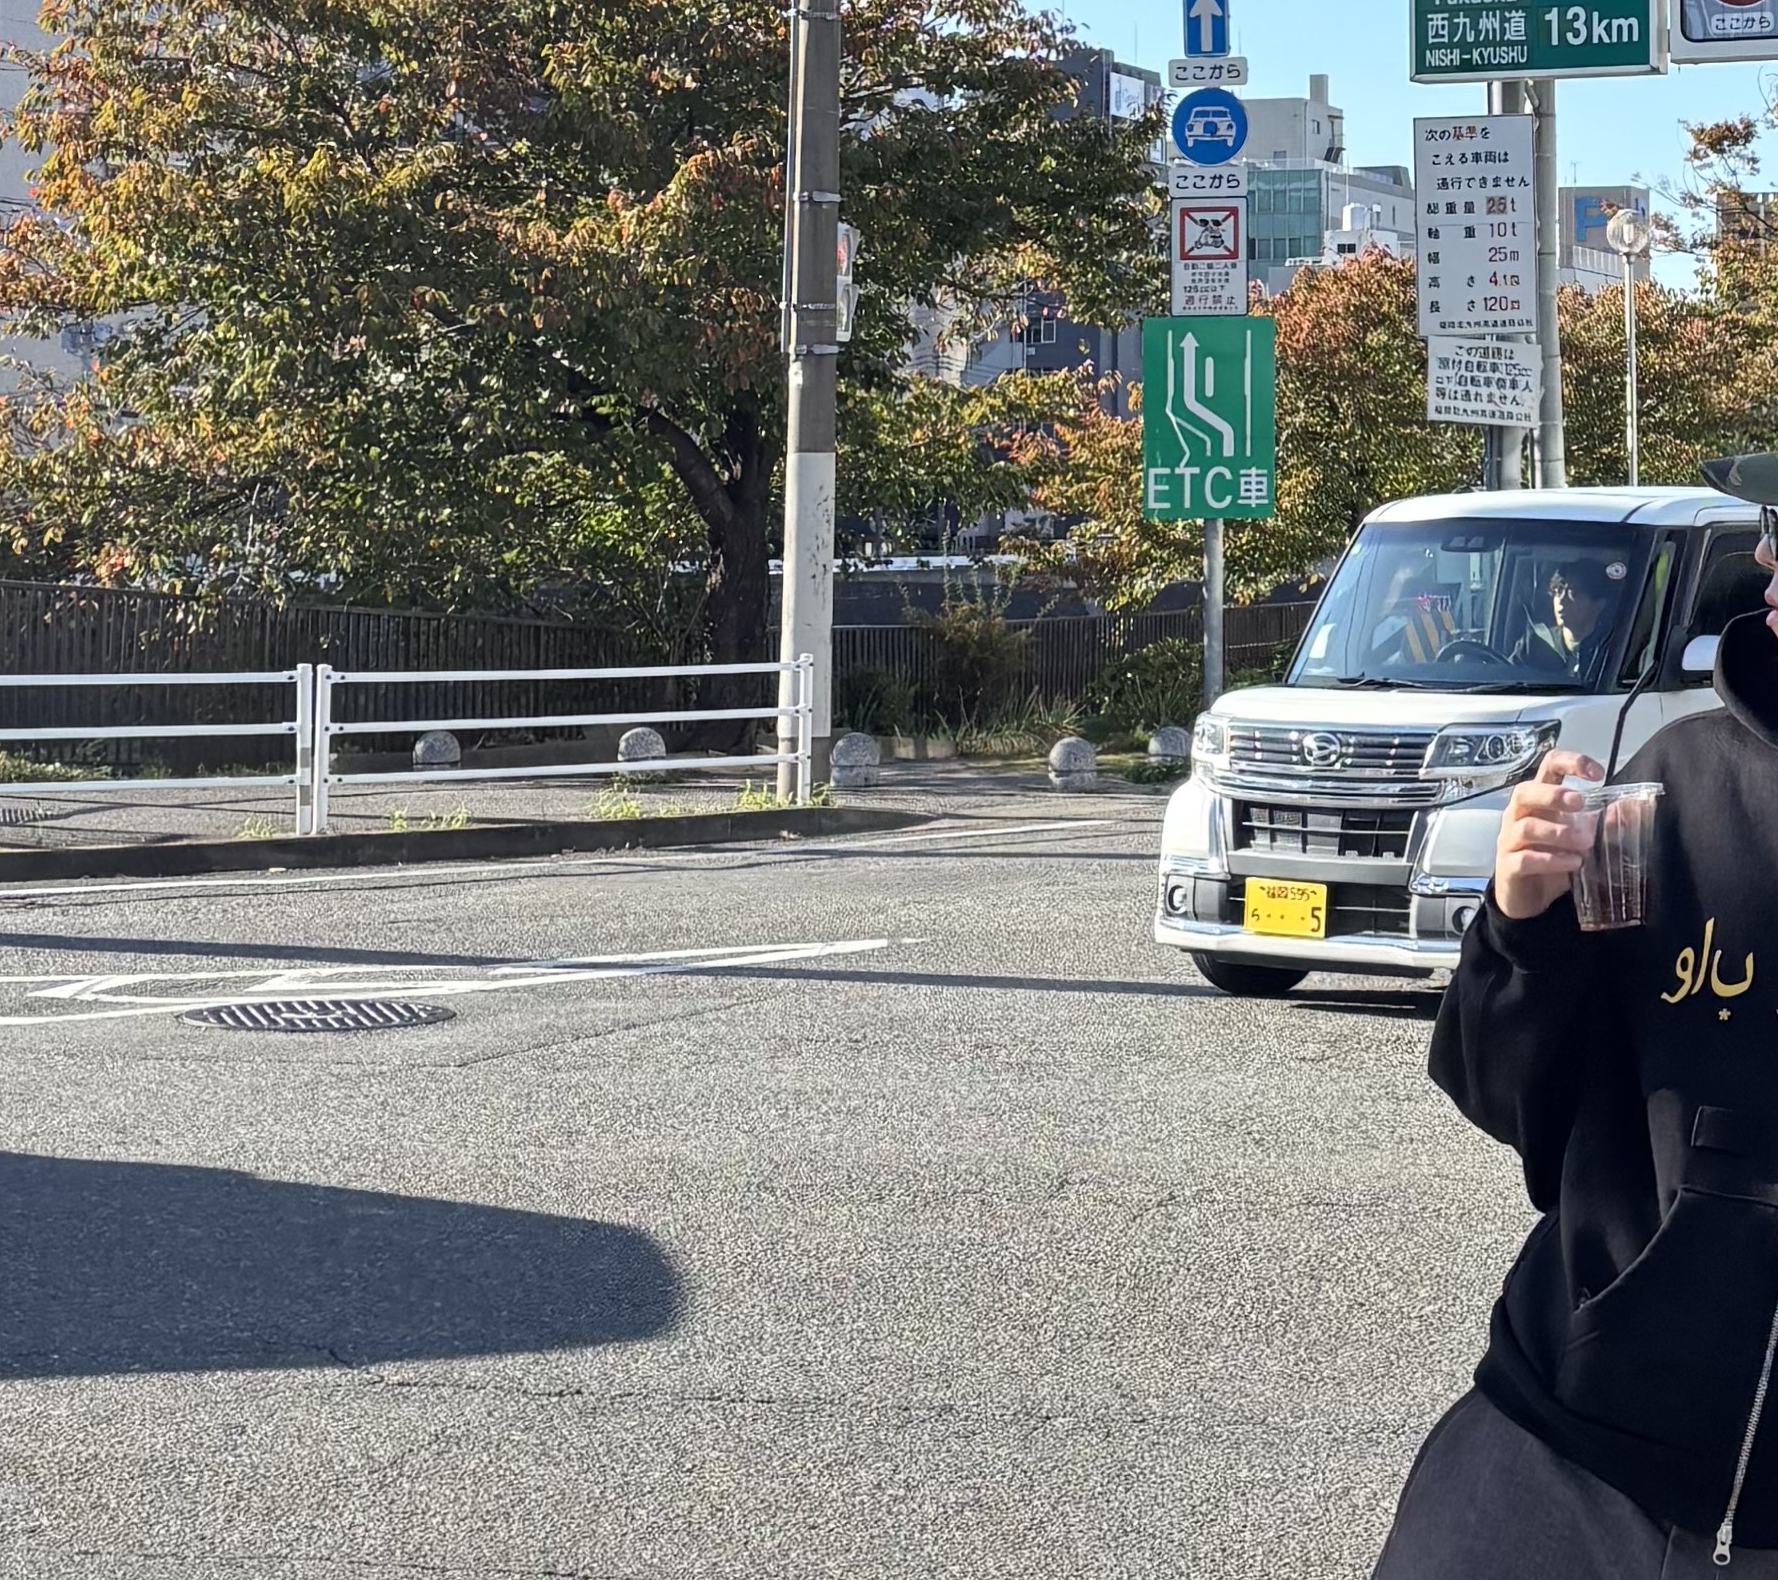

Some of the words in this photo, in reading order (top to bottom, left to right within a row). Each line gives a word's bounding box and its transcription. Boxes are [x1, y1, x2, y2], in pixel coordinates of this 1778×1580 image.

[1426, 9, 1528, 45] 西九州道
[1543, 5, 1639, 46] 13km
[1714, 14, 1771, 32] ここから
[1175, 63, 1241, 81] ここから
[1175, 173, 1241, 190] ここから
[1436, 175, 1530, 191] 通行できません
[1147, 465, 1269, 509] ETC車
